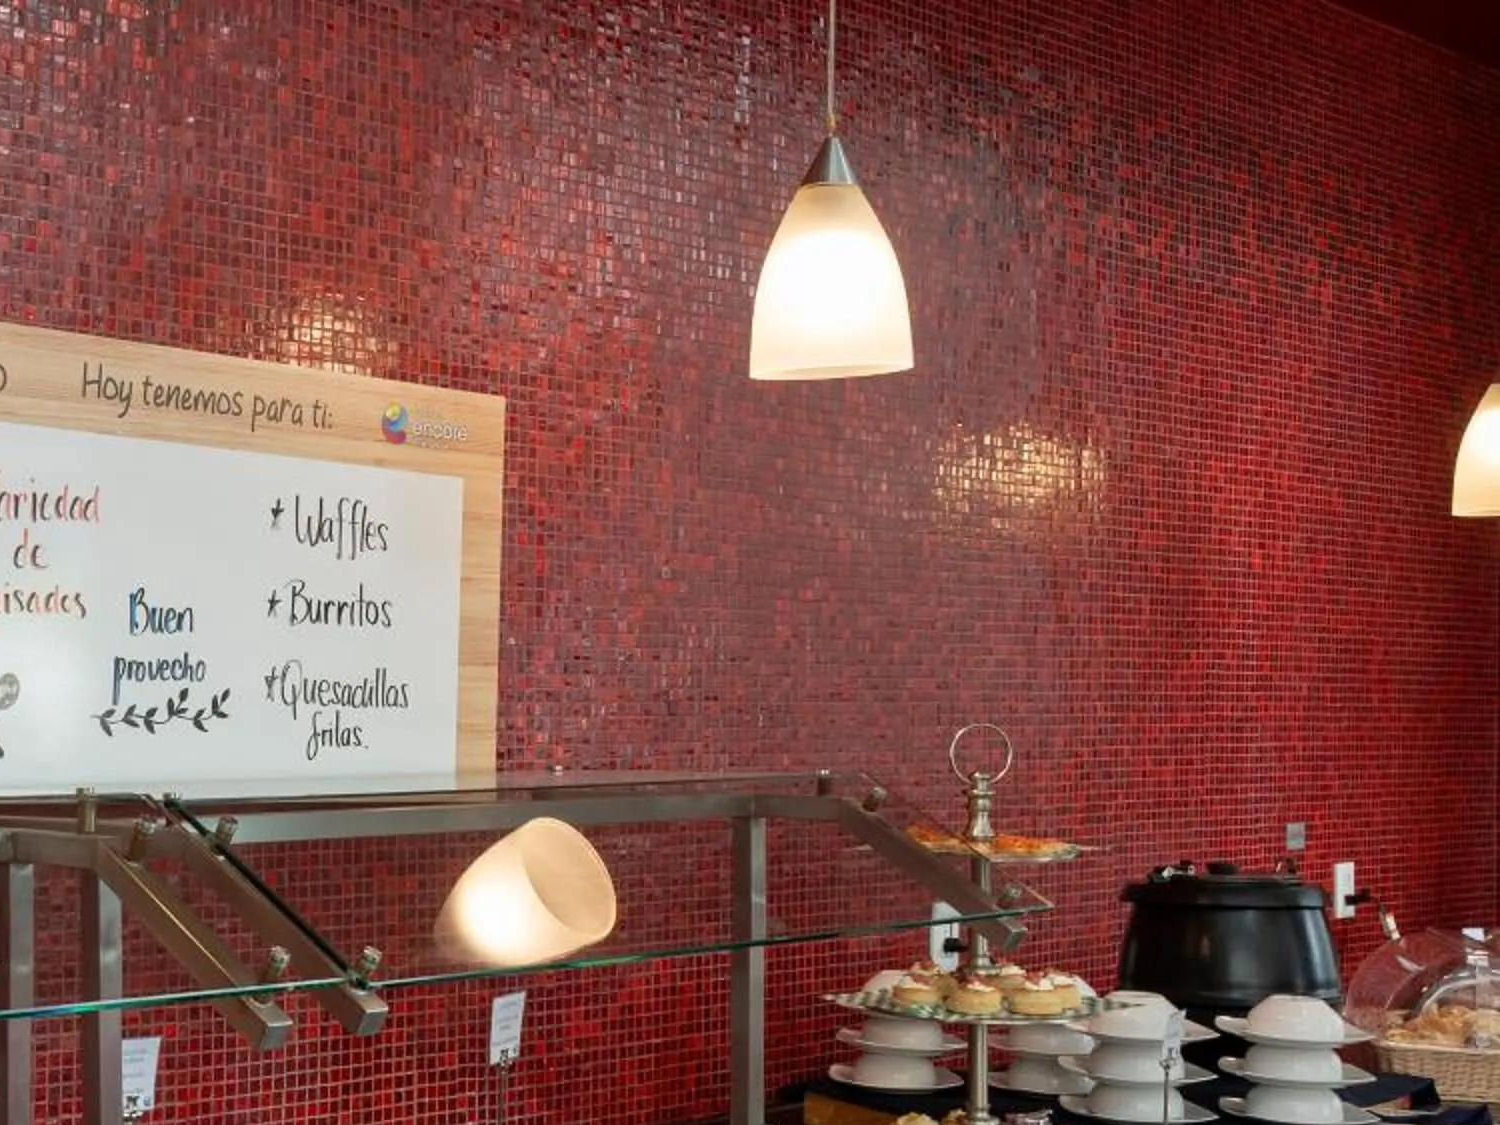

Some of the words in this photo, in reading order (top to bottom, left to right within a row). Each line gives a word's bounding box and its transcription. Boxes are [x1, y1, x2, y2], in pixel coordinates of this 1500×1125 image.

[81, 361, 132, 418] Hoy
[142, 375, 244, 418] tenemos
[251, 395, 304, 432] para
[312, 398, 334, 430] ti:
[295, 495, 389, 560] Waffles
[129, 587, 194, 635] Buen
[283, 579, 393, 628] Burritos
[112, 651, 207, 706] provecho
[280, 659, 409, 721] Quesadillas
